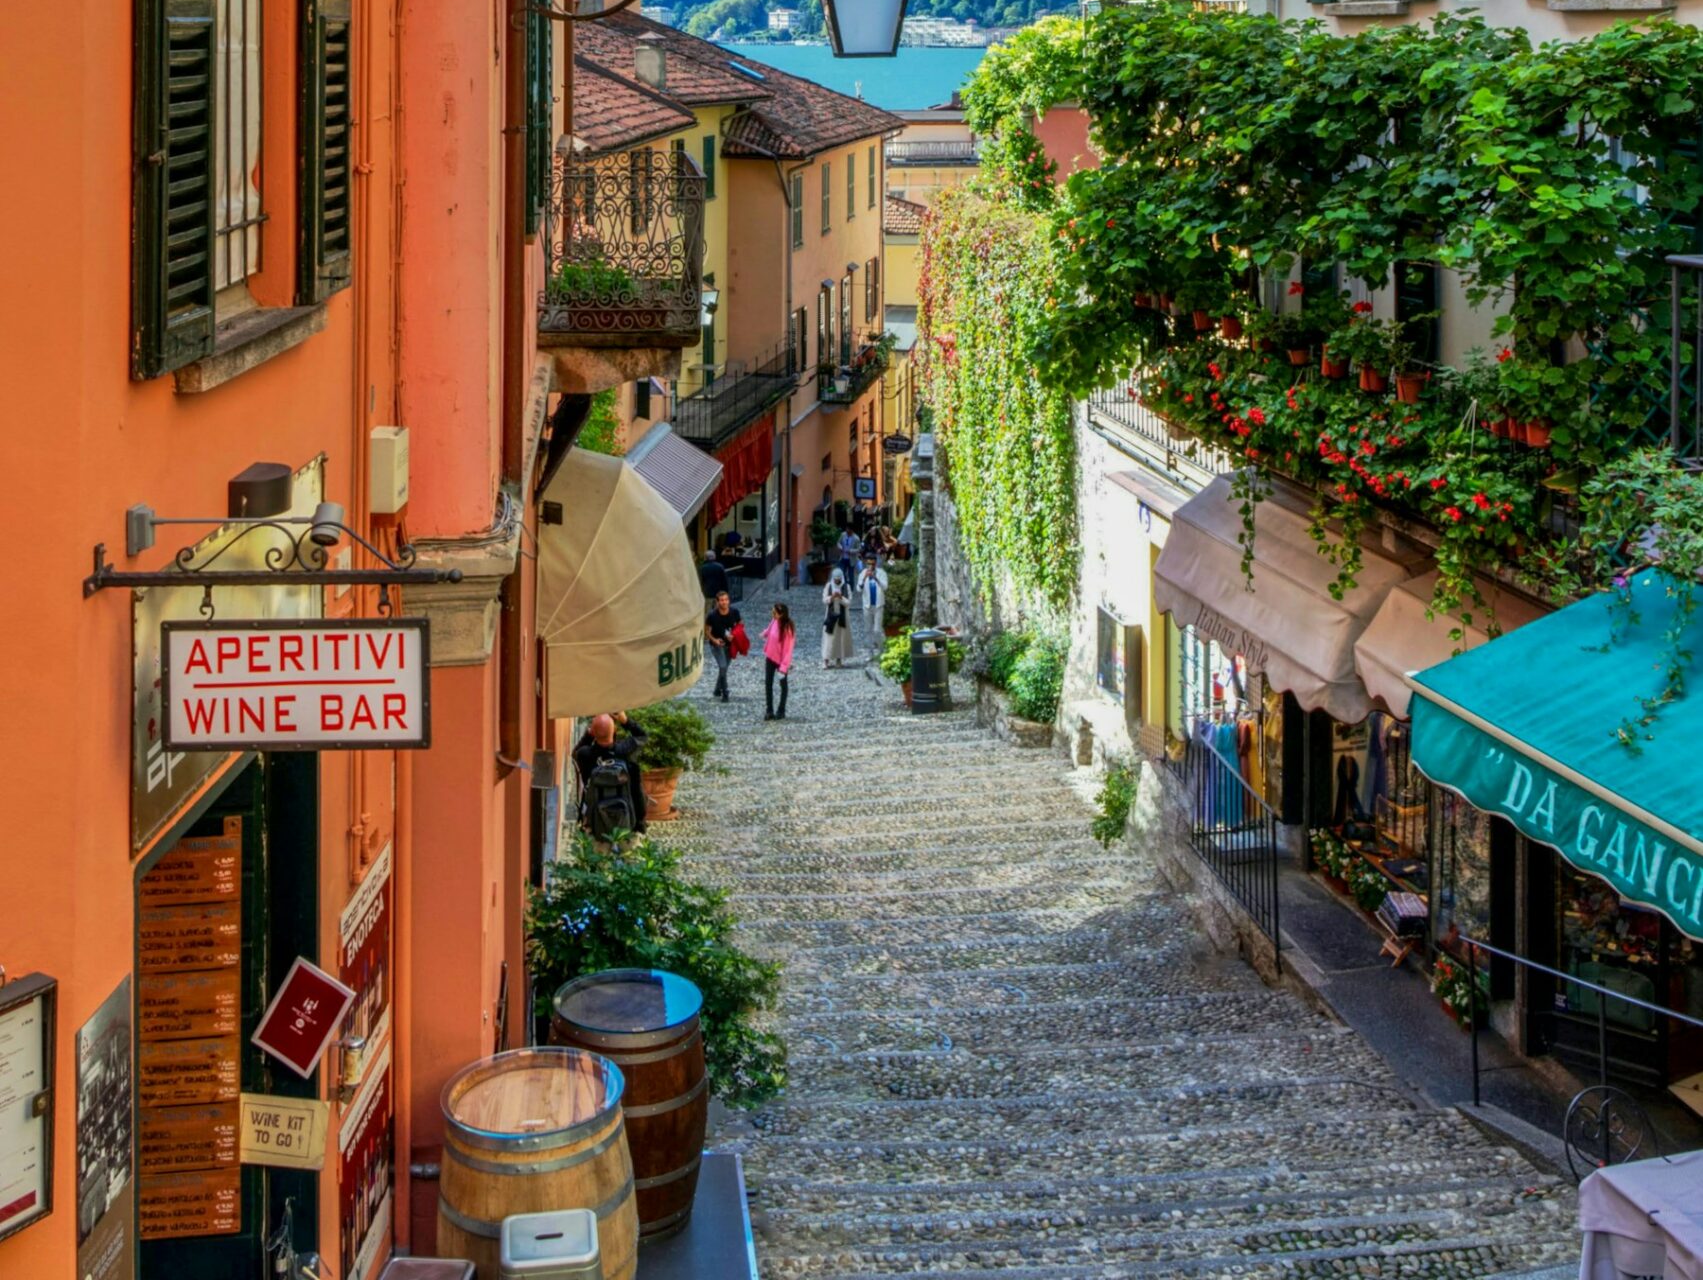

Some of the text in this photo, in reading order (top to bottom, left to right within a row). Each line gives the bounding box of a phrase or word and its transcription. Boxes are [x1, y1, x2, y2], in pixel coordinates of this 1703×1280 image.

[184, 633, 404, 675] APERITIVI
[1195, 602, 1269, 671] Italian Style
[183, 693, 408, 735] WINE BAR
[346, 891, 384, 968] ENOTECA
[254, 1129, 270, 1144] TO
[276, 1132, 293, 1148] GO
